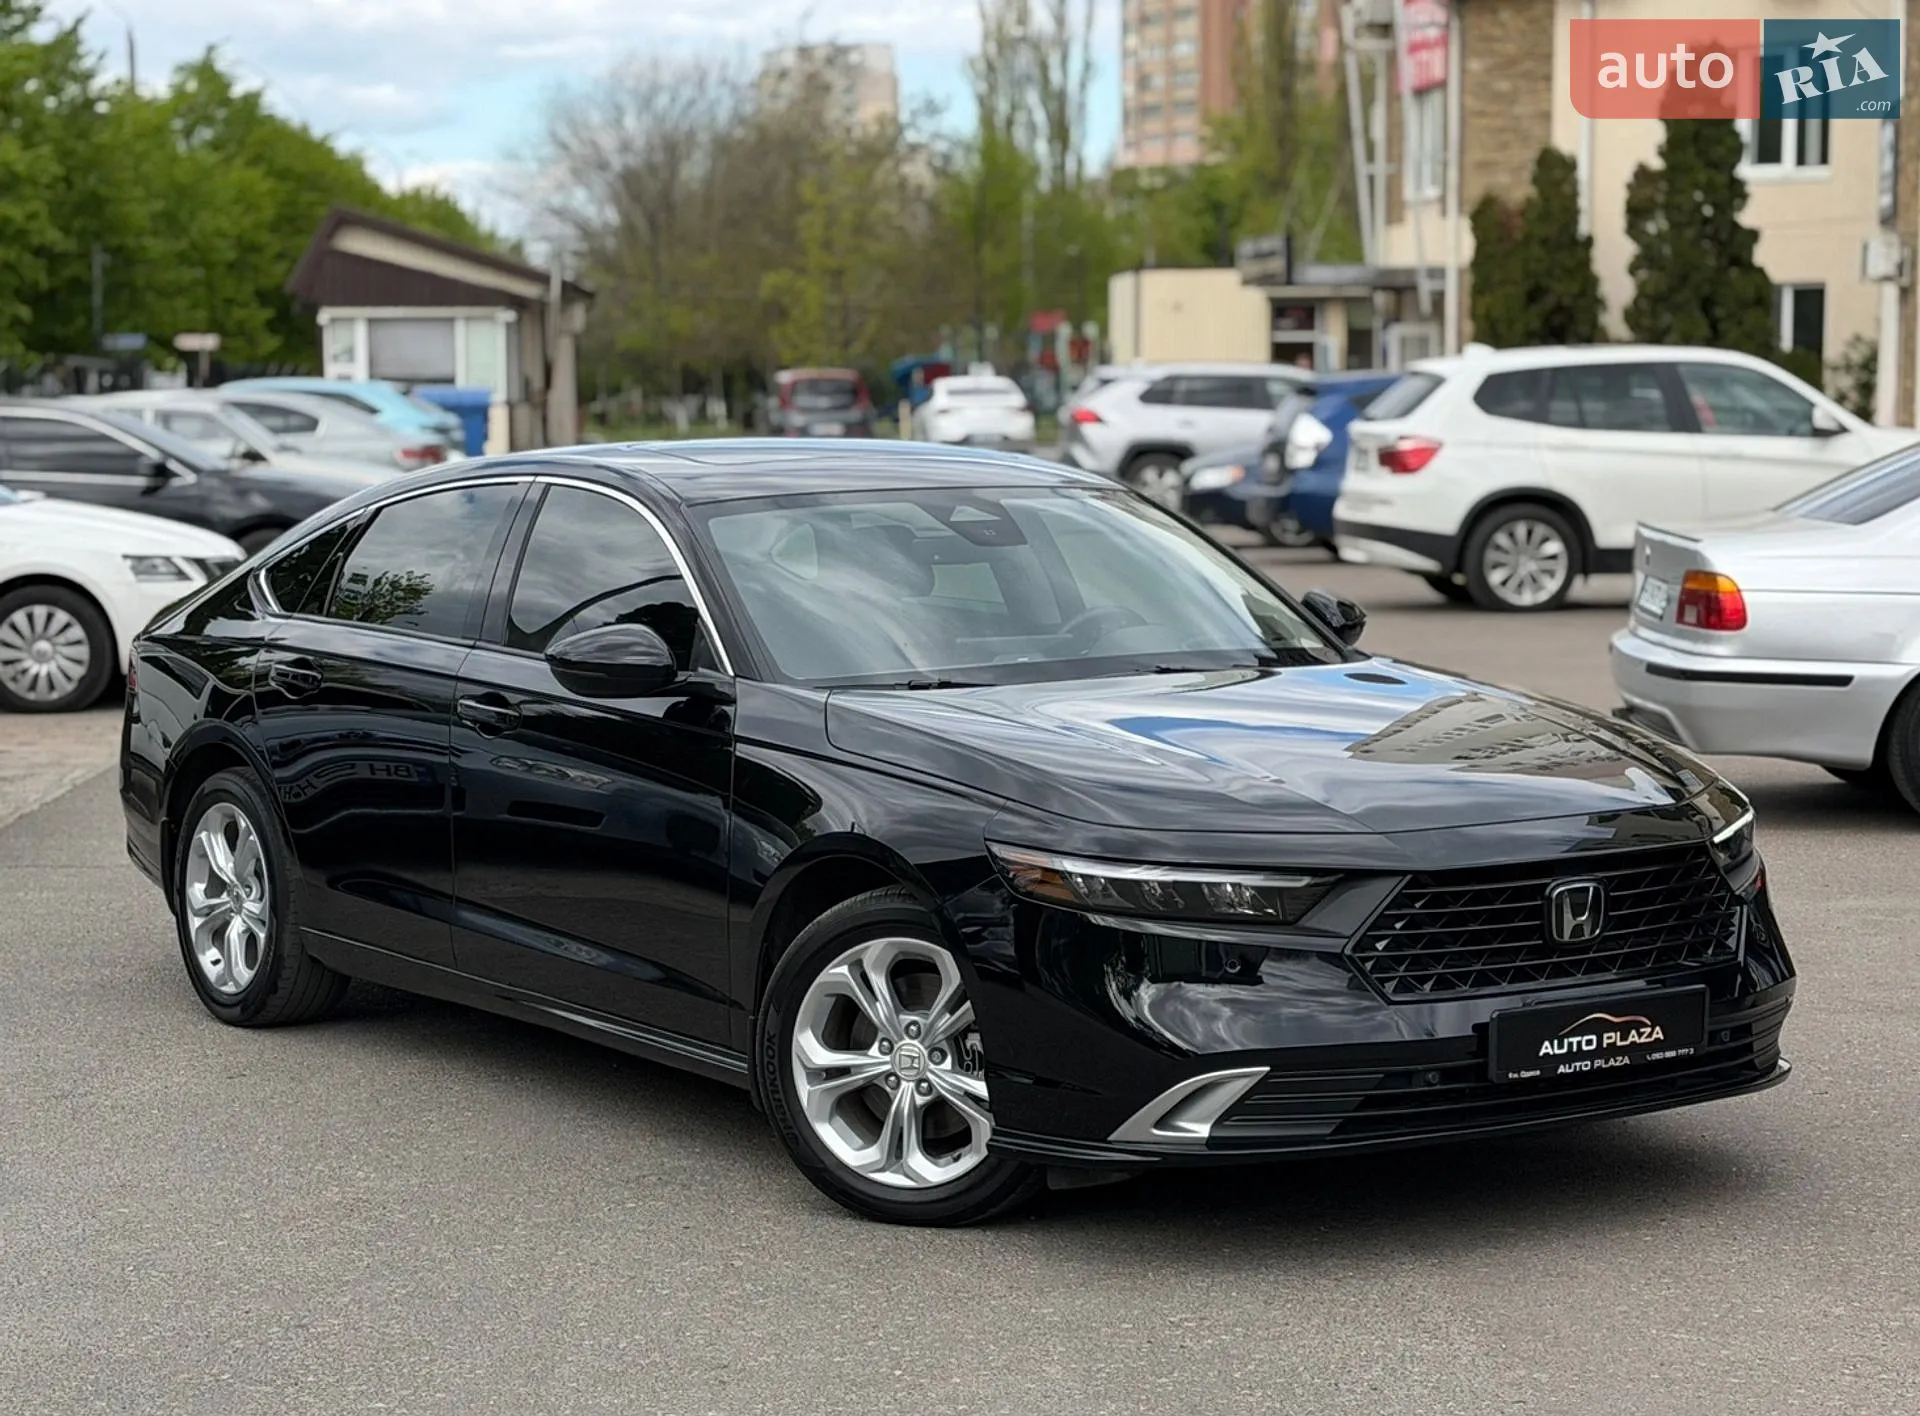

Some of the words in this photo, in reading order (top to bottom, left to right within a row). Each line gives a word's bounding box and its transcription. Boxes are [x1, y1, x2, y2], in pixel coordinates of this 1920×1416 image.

[1538, 1033, 1597, 1057] AUTO
[1602, 1025, 1664, 1049] PLAZA
[1556, 1060, 1591, 1075] AUTO
[1593, 1055, 1631, 1070] PLAZA
